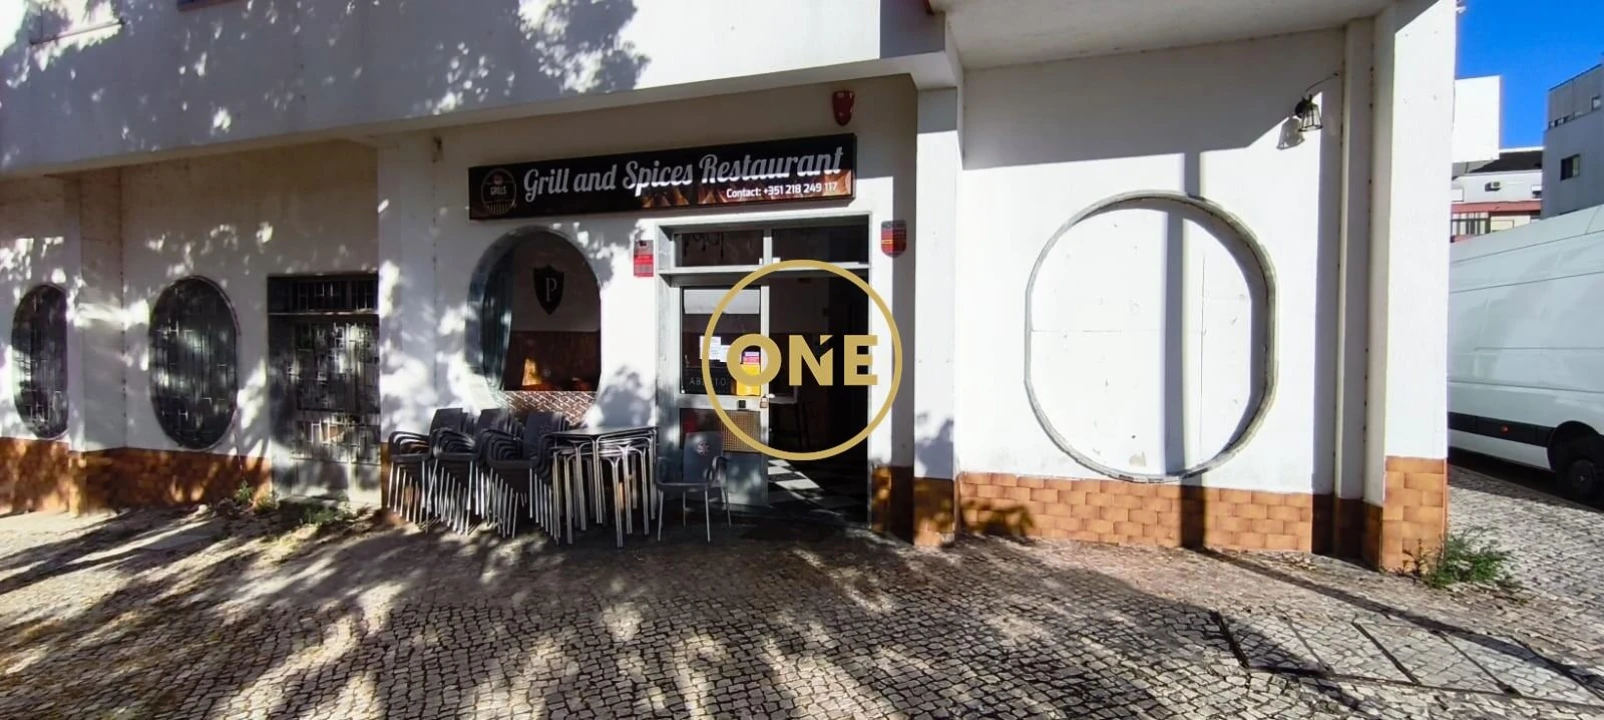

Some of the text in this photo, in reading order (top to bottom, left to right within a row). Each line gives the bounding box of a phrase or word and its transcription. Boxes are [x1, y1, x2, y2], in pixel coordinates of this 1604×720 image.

[523, 146, 844, 203] Grill and Spices Restaurant
[726, 181, 838, 199] Contact: +351 218 249 117
